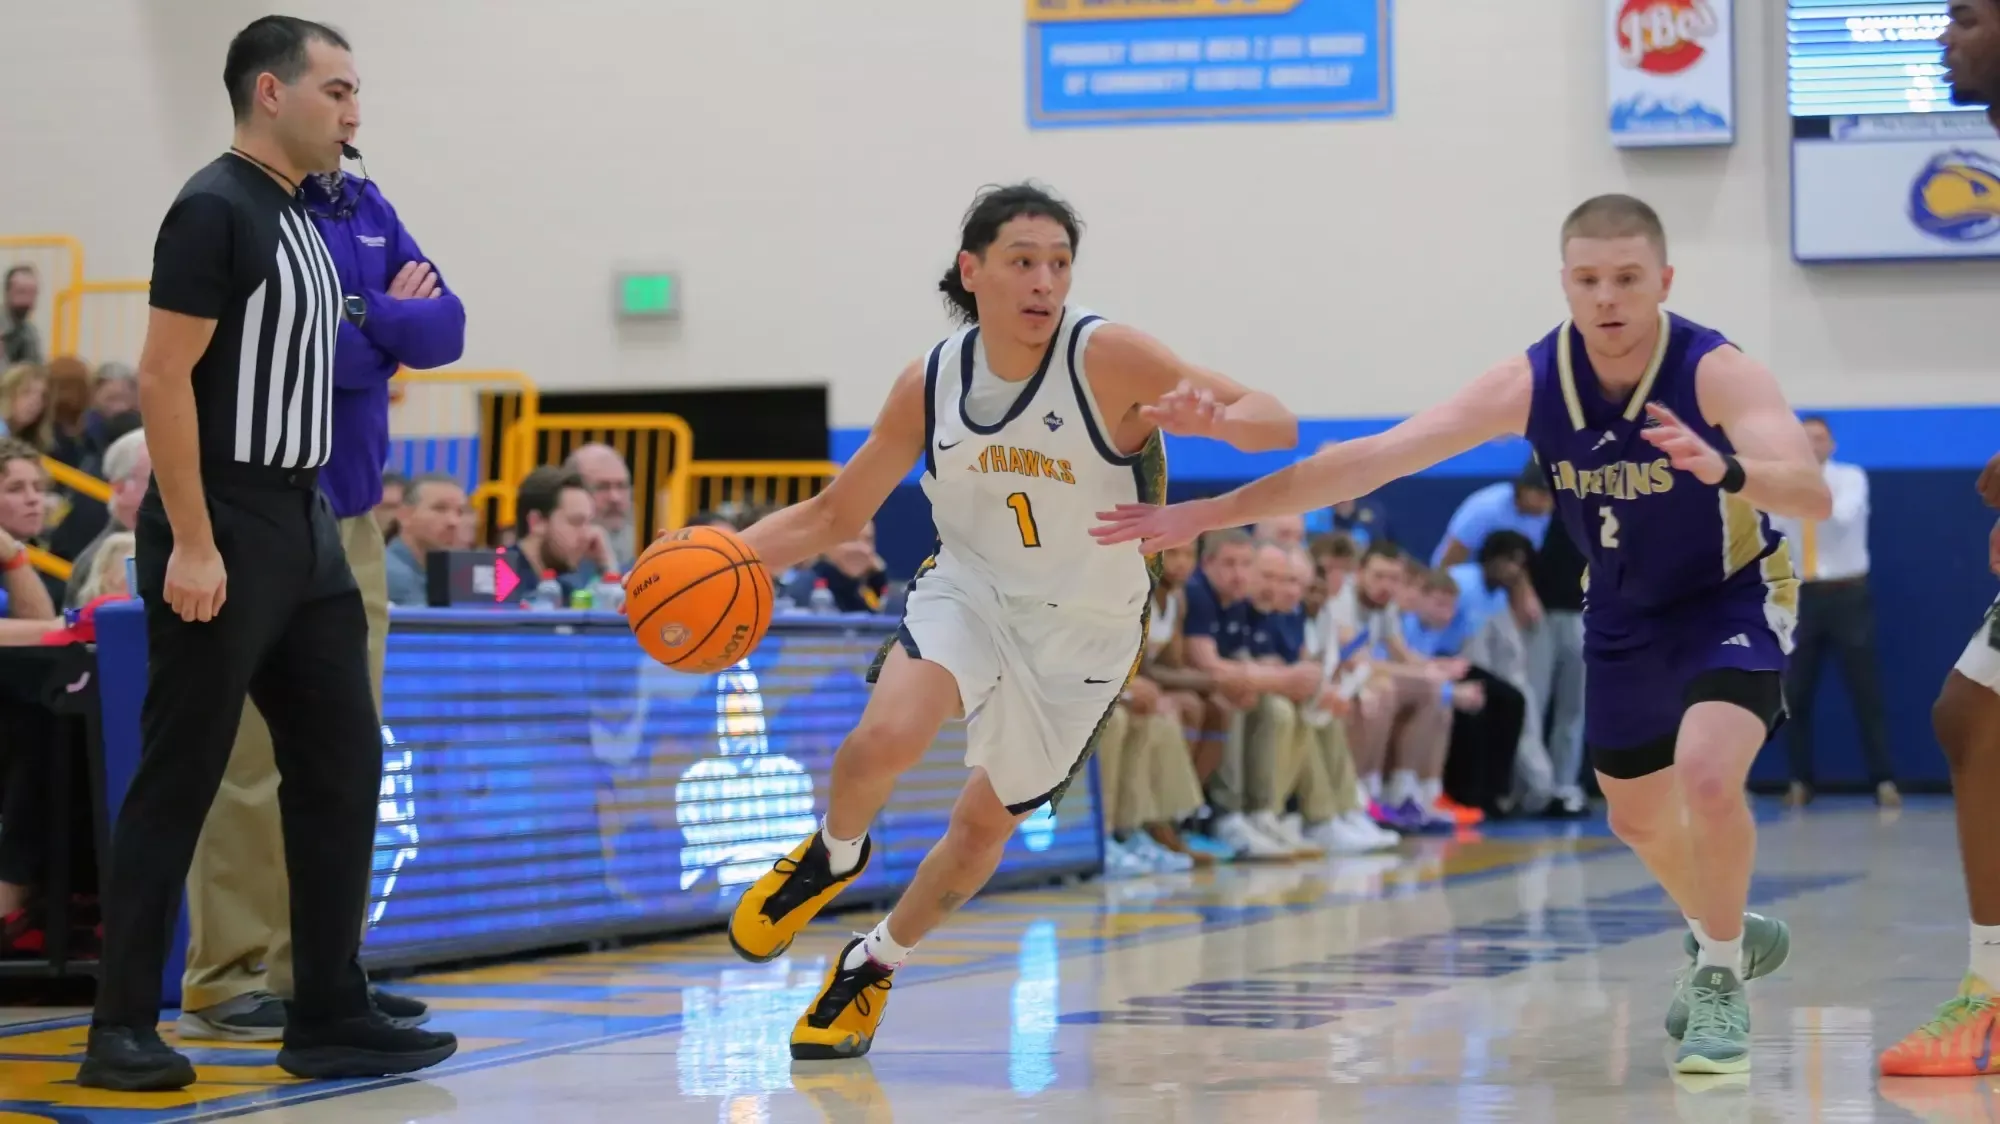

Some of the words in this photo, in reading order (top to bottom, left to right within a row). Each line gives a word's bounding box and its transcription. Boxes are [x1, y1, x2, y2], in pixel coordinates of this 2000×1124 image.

[966, 445, 1076, 485] YHAWKS
[1006, 492, 1042, 548] 1
[1598, 505, 1620, 549] 2
